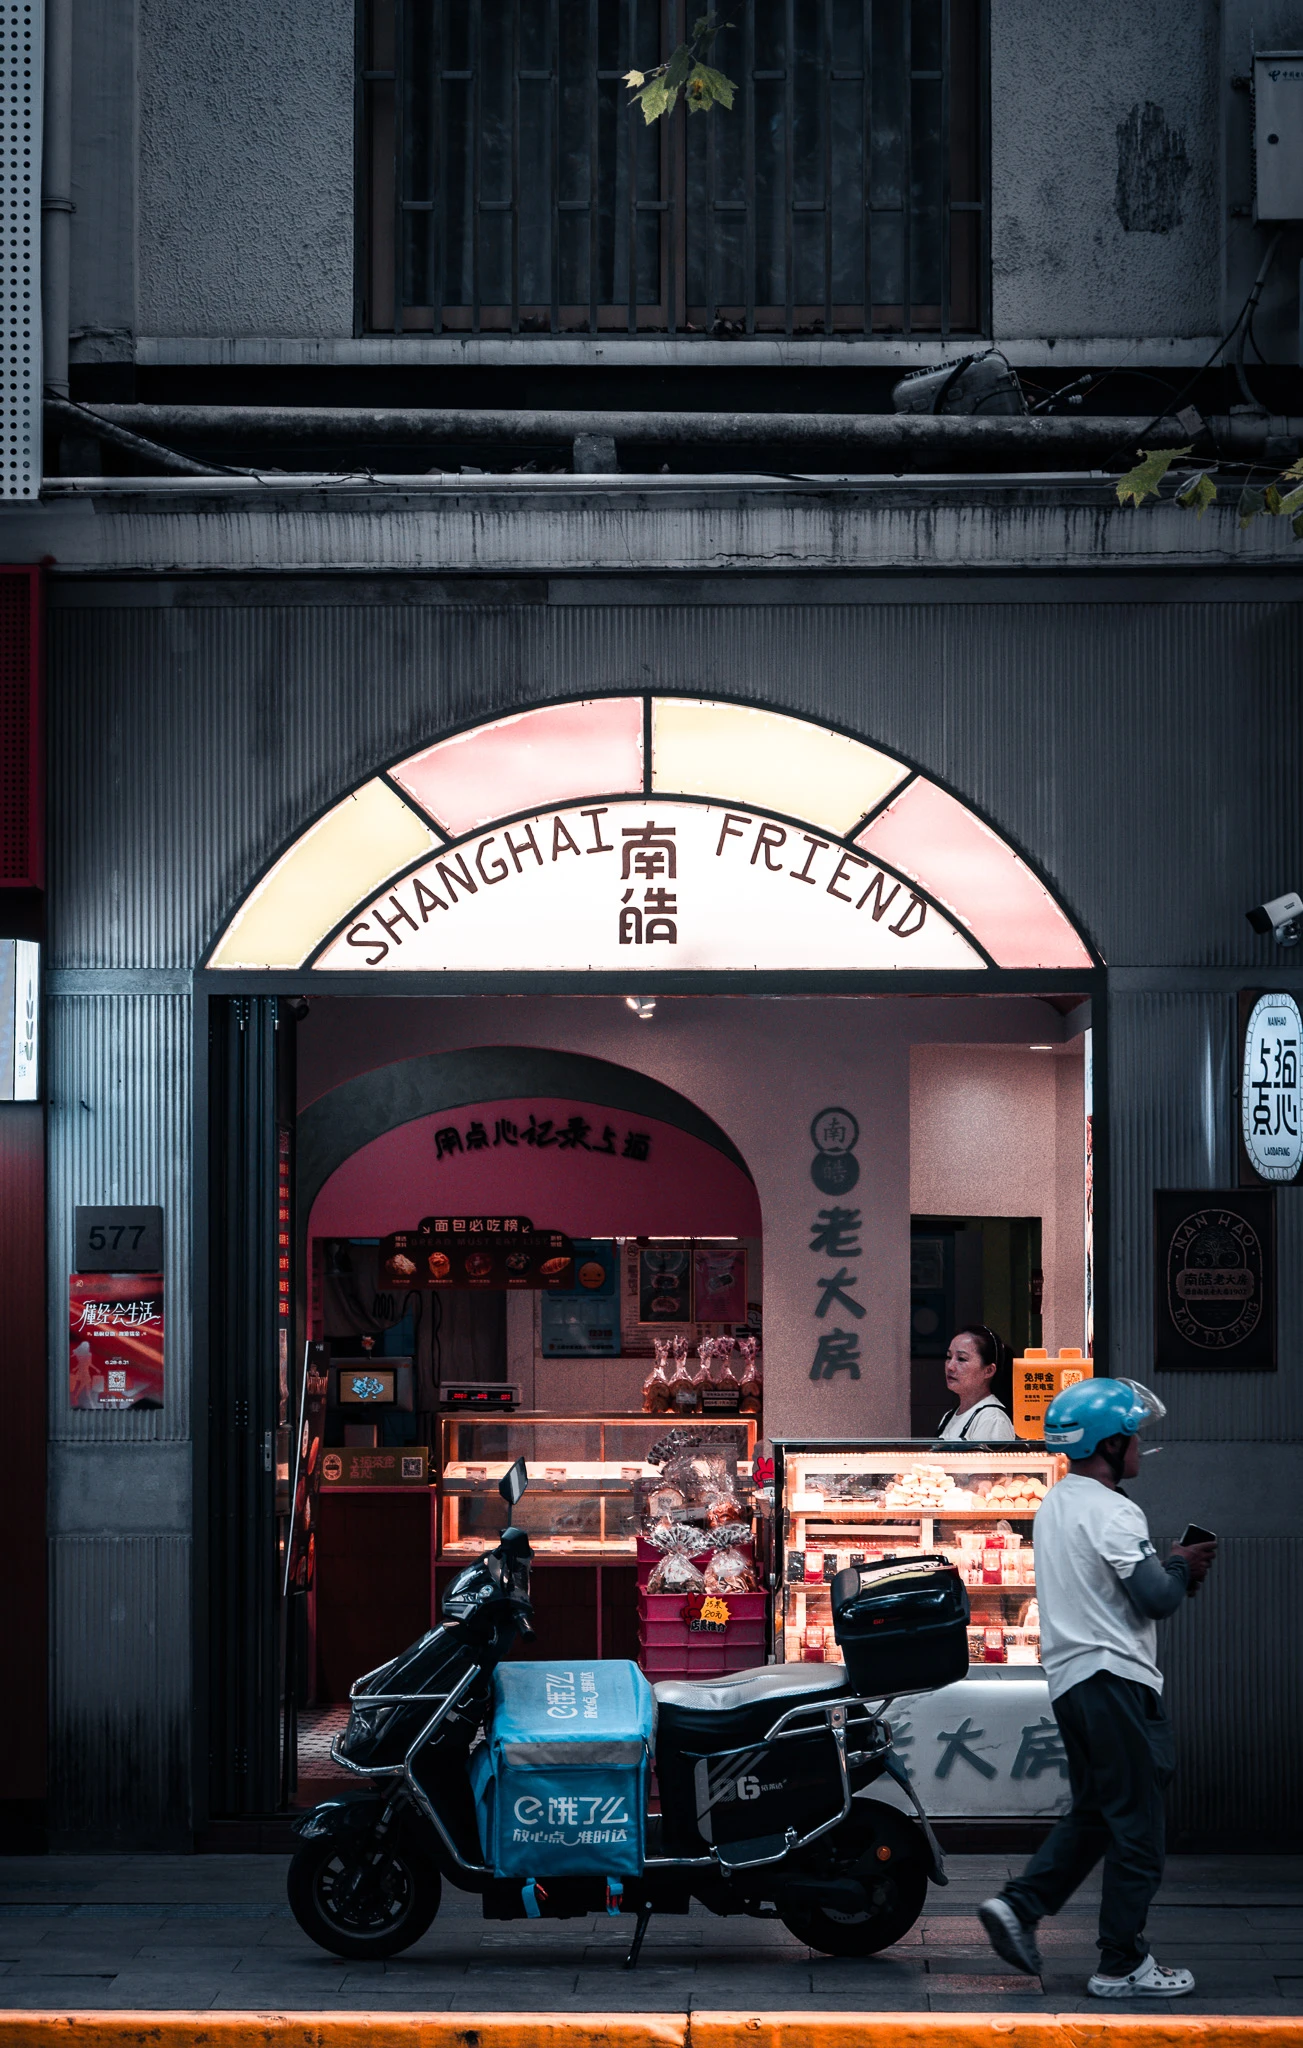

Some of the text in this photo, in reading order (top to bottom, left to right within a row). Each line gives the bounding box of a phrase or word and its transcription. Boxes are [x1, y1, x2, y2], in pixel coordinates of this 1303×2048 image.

[345, 807, 931, 966] SHANGHAI FRIEND
[618, 820, 678, 945] 南皓
[1267, 1016, 1287, 1026] NANHAO
[88, 1225, 146, 1251] 577
[435, 1219, 519, 1232] 面包必吃榜
[1174, 1213, 1255, 1250] NAN HAO
[809, 1206, 867, 1381] 老大房
[1175, 1307, 1197, 1336] LAO
[1204, 1331, 1227, 1345] DA
[1229, 1301, 1260, 1339] FANG
[1024, 1372, 1054, 1382] 免押金
[1024, 1383, 1054, 1391] 借充电宝
[704, 1609, 723, 1619] 20元
[548, 1796, 629, 1825] 饿了么
